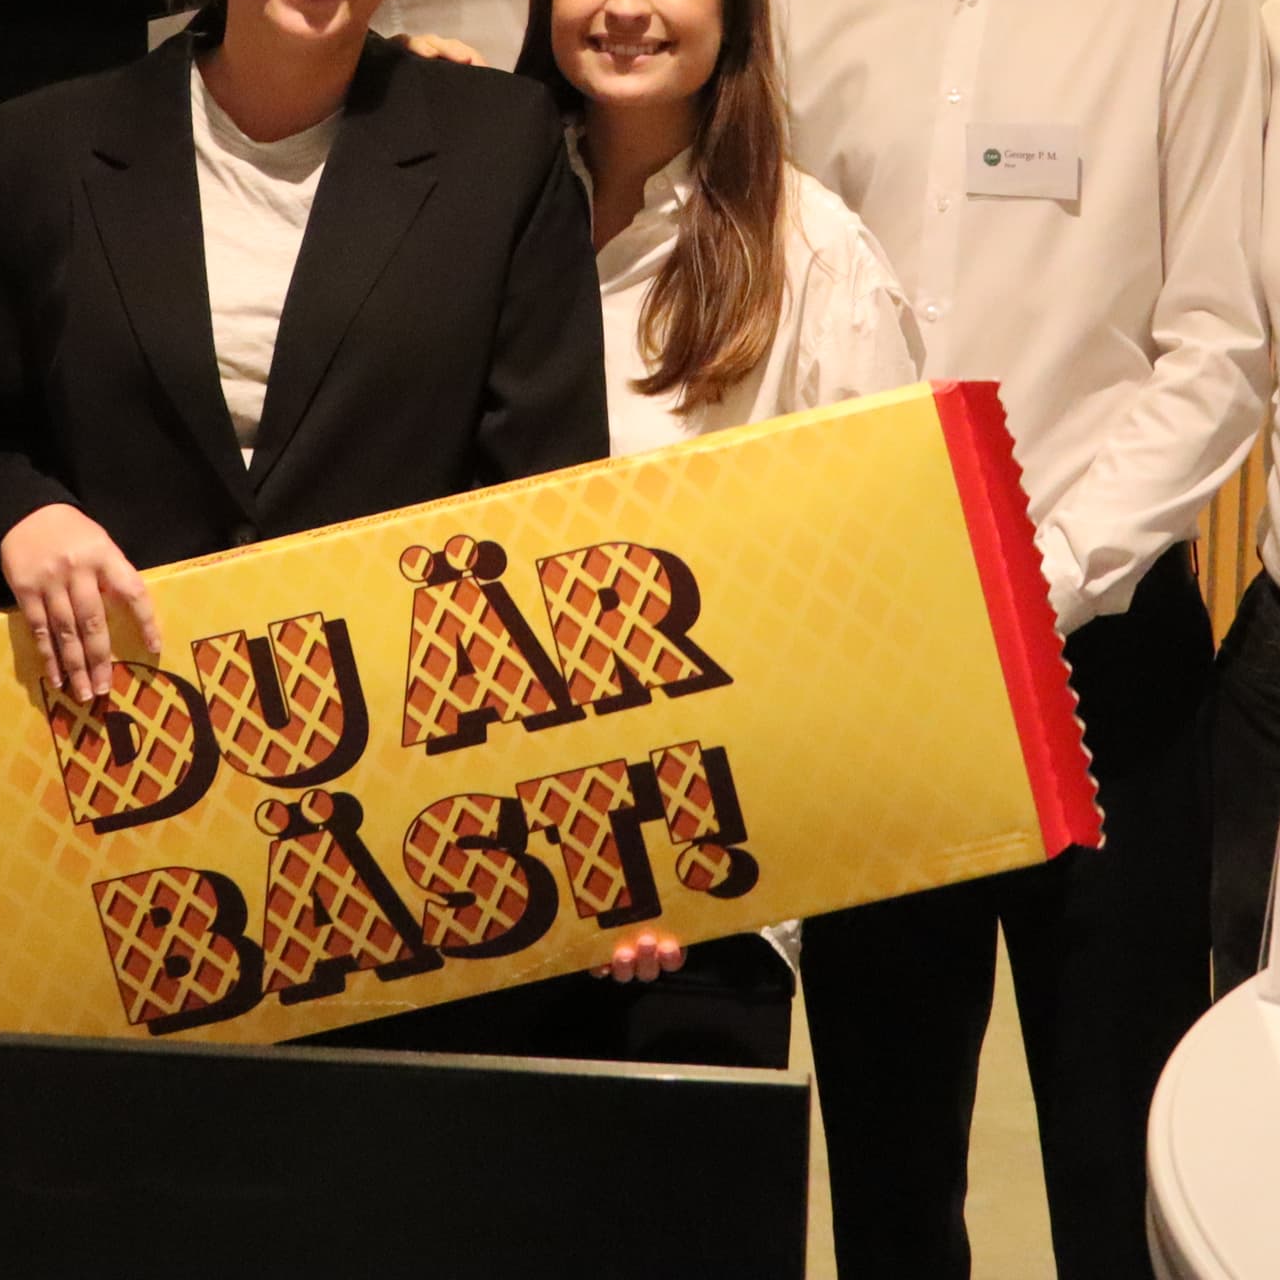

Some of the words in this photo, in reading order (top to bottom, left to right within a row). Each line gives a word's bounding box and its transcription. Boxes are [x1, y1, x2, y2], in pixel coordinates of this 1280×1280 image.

[40, 611, 370, 834] DU
[401, 535, 734, 756] ÄR
[91, 739, 760, 1035] BÄST!
